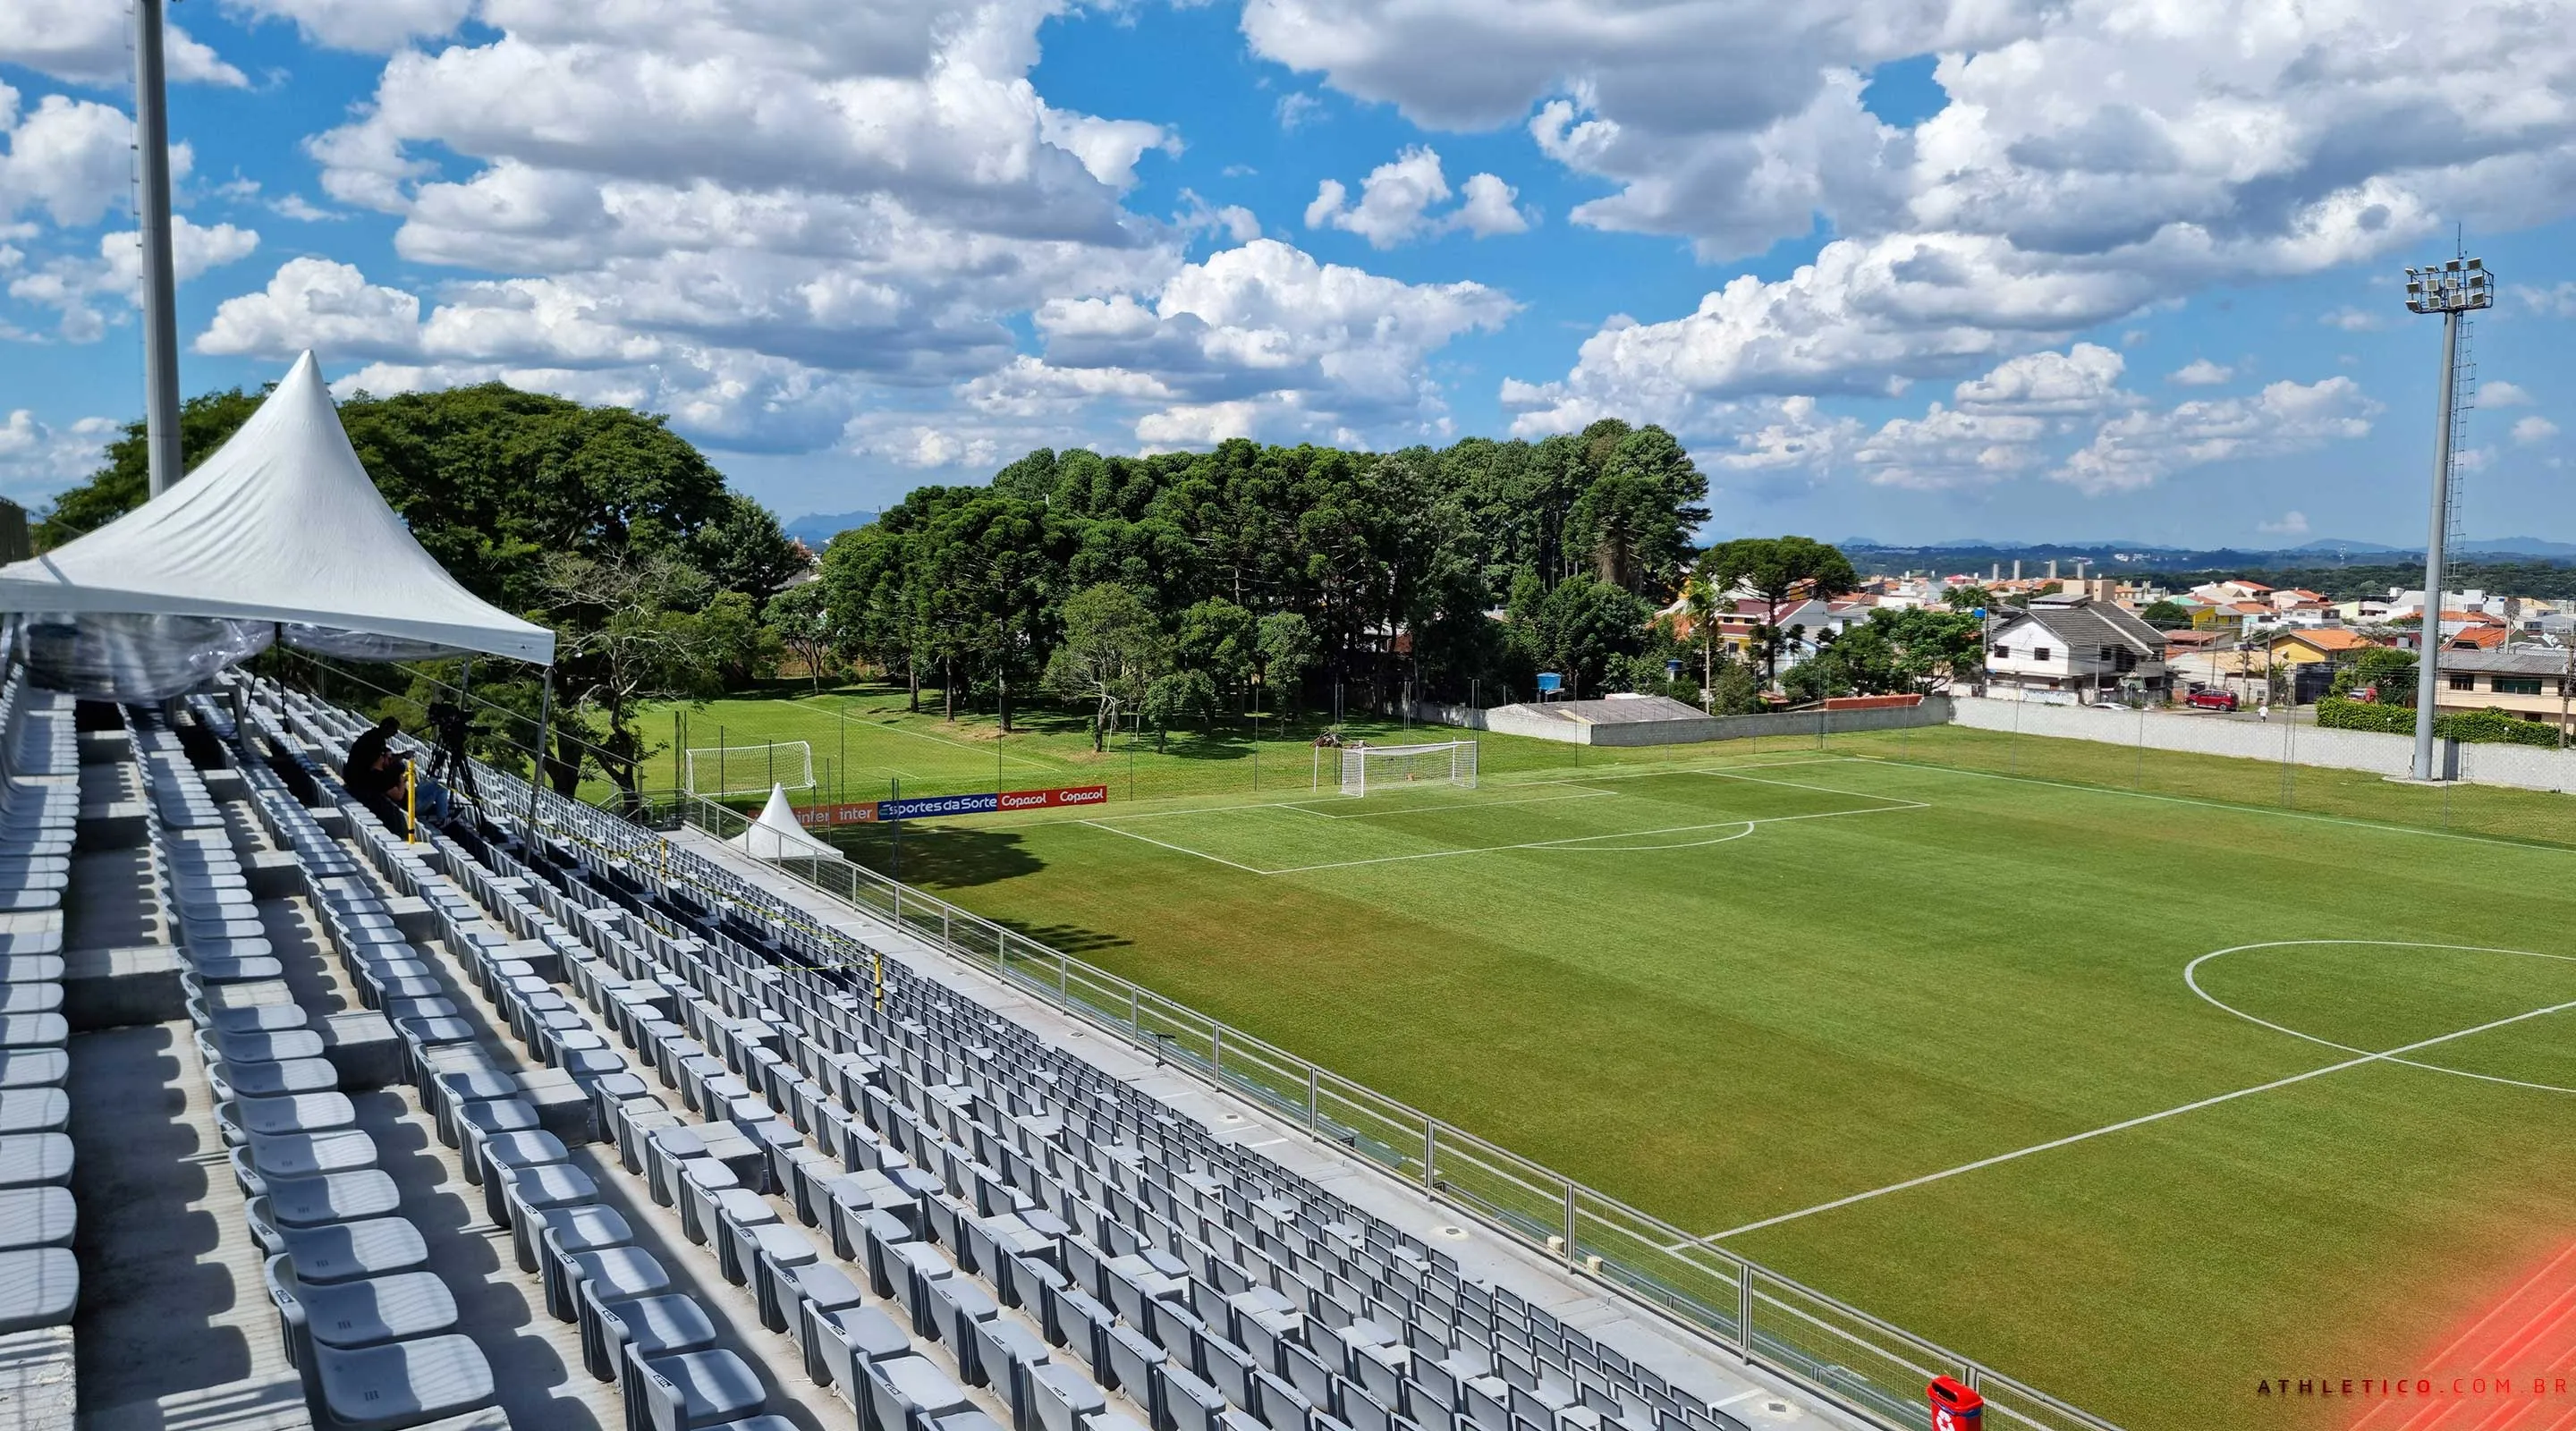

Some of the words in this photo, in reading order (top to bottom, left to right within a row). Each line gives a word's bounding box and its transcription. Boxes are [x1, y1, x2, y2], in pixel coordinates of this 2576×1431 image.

[1001, 792, 1046, 809] Copacol
[1059, 788, 1104, 804] Copacol
[839, 808, 873, 821] inter
